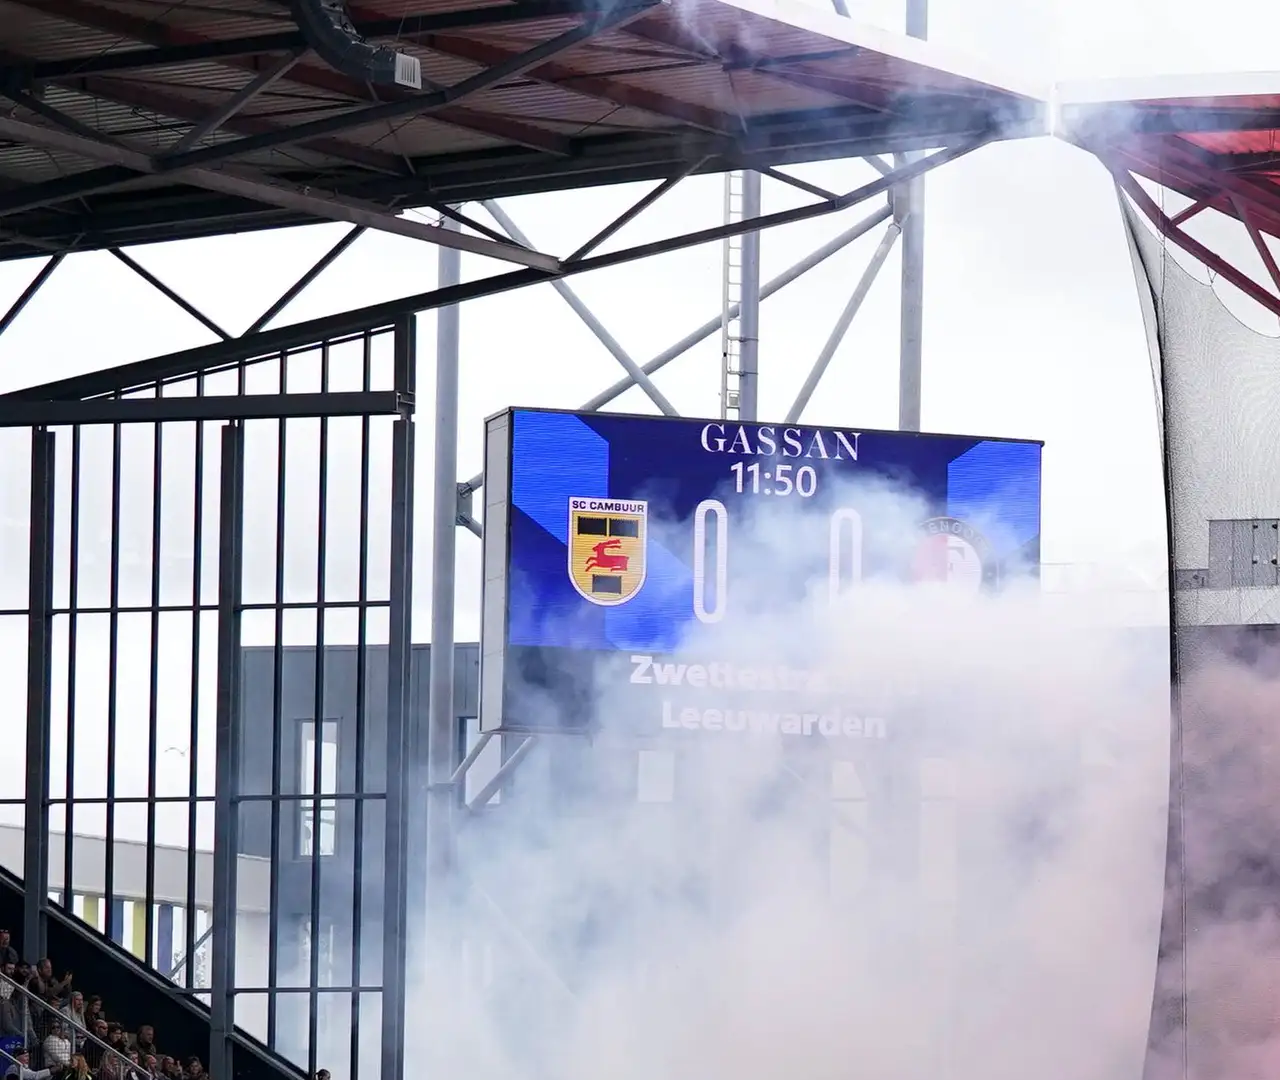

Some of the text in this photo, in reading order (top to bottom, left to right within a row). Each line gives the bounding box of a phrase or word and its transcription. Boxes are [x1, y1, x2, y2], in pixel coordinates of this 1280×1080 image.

[701, 422, 862, 462] GASSAN
[730, 461, 817, 498] 11:50
[572, 500, 645, 513] SC CAMBUUR
[661, 701, 887, 739] Leeuwarden
